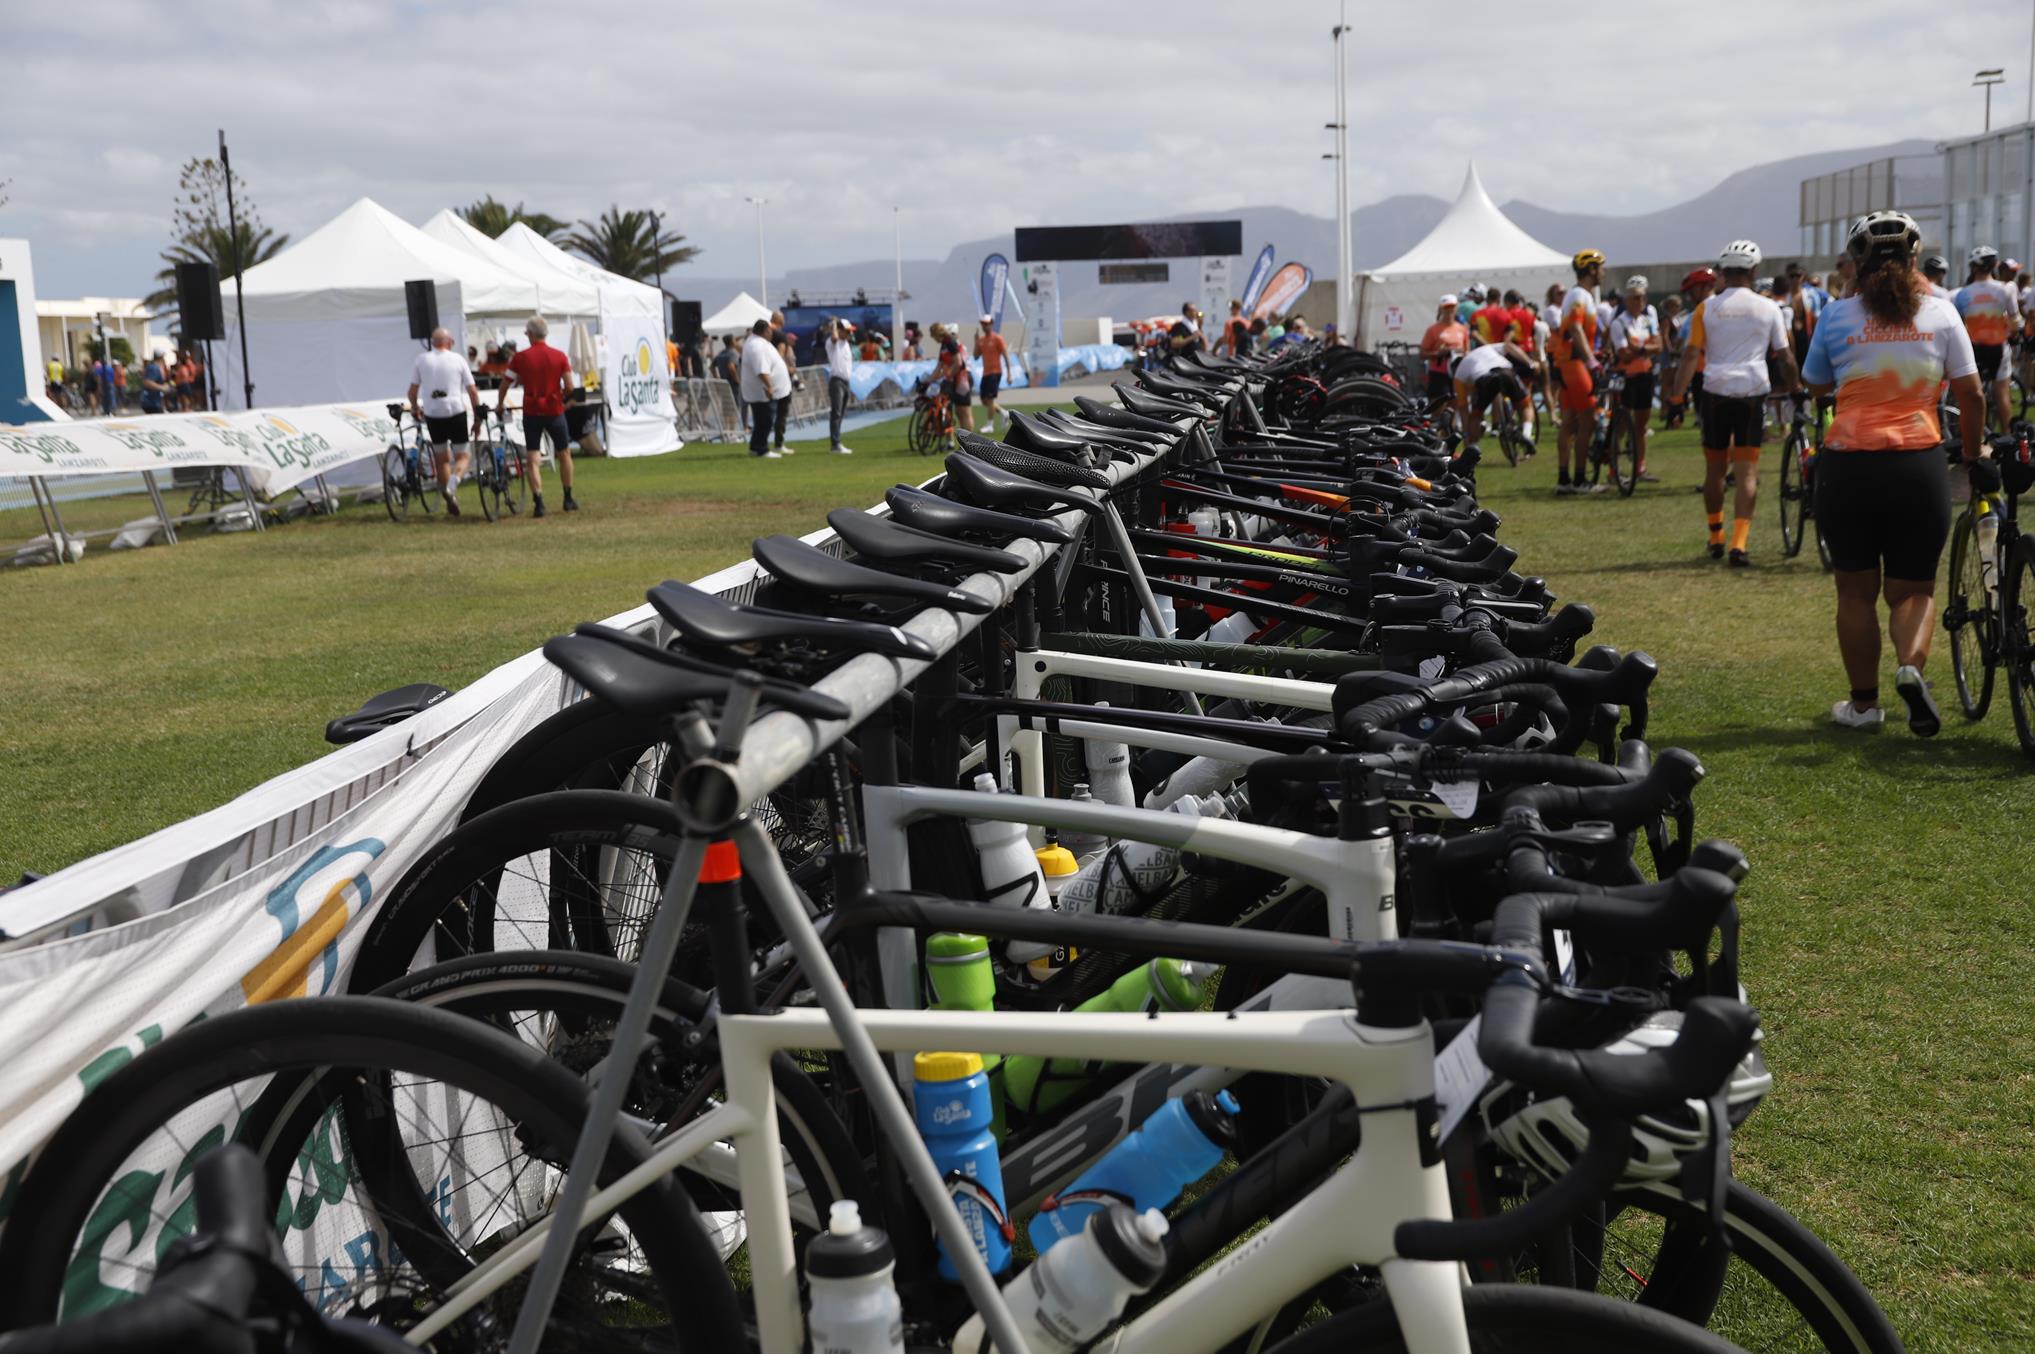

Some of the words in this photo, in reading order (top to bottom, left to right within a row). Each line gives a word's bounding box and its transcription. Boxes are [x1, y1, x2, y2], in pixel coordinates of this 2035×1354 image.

[621, 354, 638, 377] Club
[1278, 574, 1350, 596] PINARELLO
[410, 975, 459, 995] GRAND
[461, 966, 497, 981] PRIX
